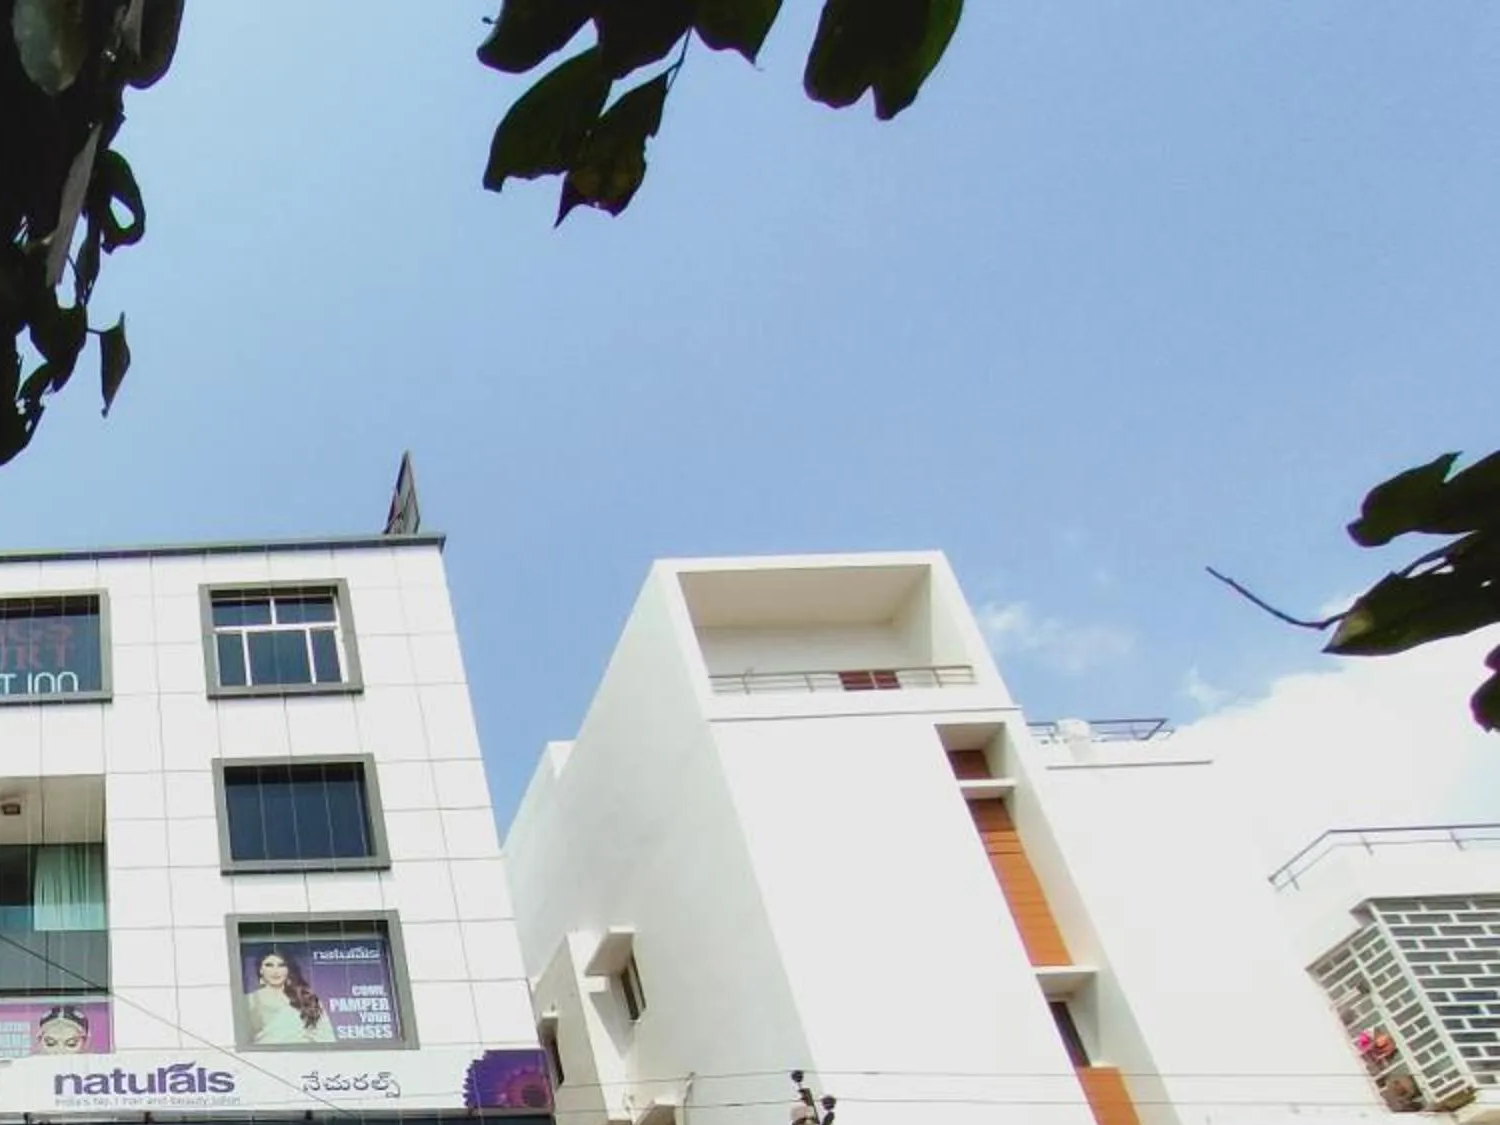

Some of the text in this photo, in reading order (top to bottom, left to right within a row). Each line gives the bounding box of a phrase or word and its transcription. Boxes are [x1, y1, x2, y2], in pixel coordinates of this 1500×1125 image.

[330, 998, 390, 1013] PAMPER
[337, 1025, 393, 1039] SENSES
[54, 1060, 236, 1096] naturals
